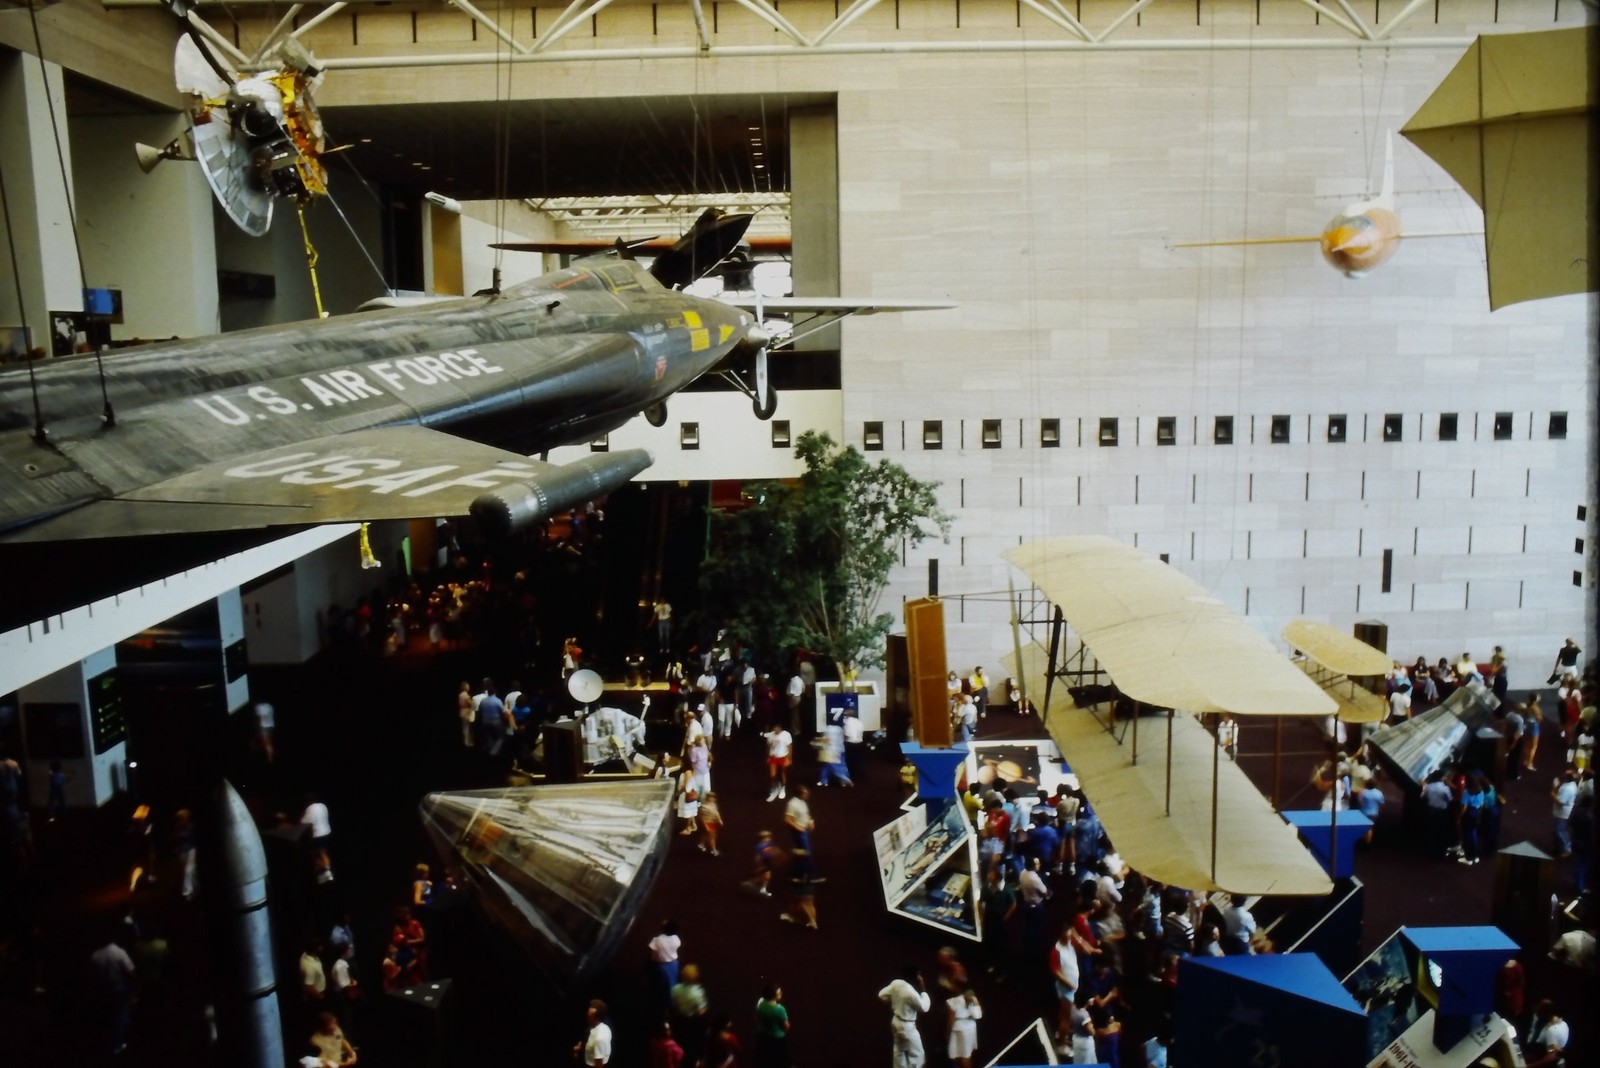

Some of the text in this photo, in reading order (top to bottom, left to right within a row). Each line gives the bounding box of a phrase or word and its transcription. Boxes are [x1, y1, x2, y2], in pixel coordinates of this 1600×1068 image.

[193, 348, 504, 425] U.S. AIR FORCE
[224, 451, 538, 498] USAF
